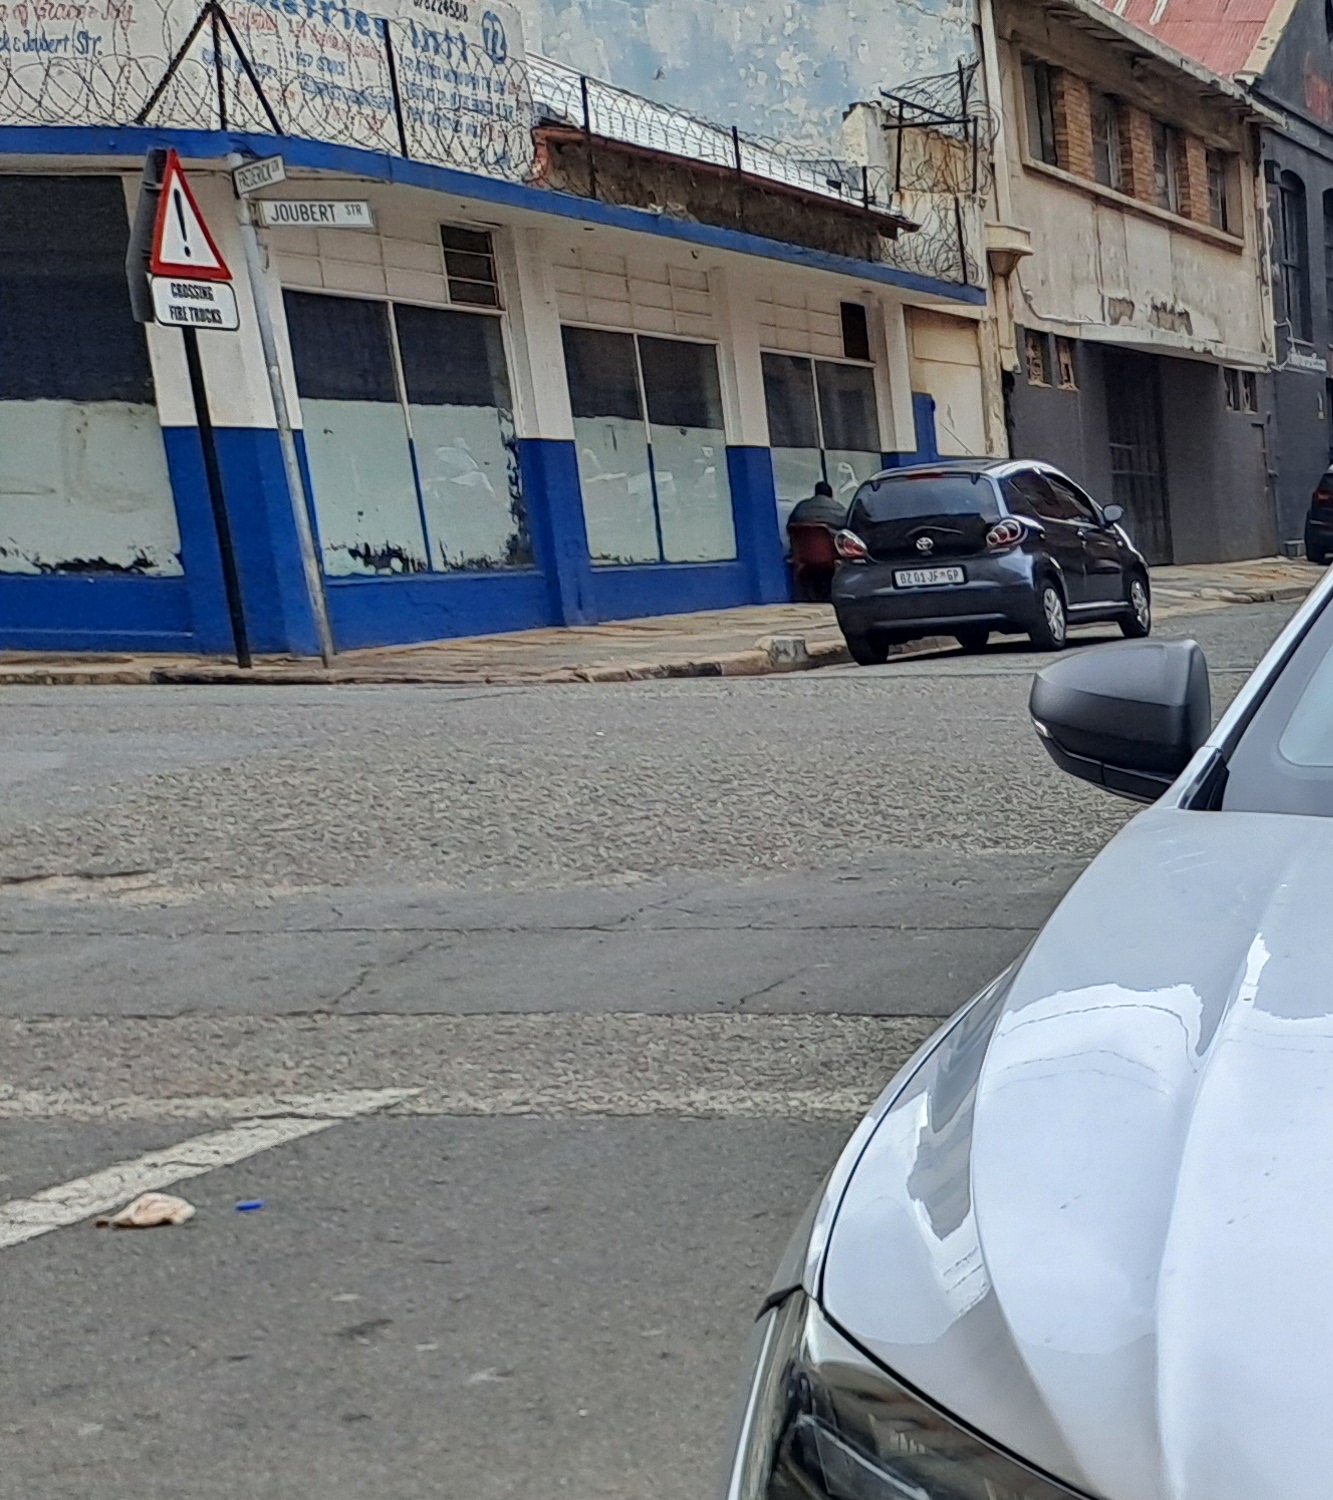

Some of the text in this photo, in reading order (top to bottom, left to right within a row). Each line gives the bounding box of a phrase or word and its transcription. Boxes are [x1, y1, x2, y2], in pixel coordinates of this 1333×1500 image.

[271, 203, 364, 223] JOUBERT STR
[170, 282, 214, 301] CROSSING
[168, 304, 188, 321] FIRE
